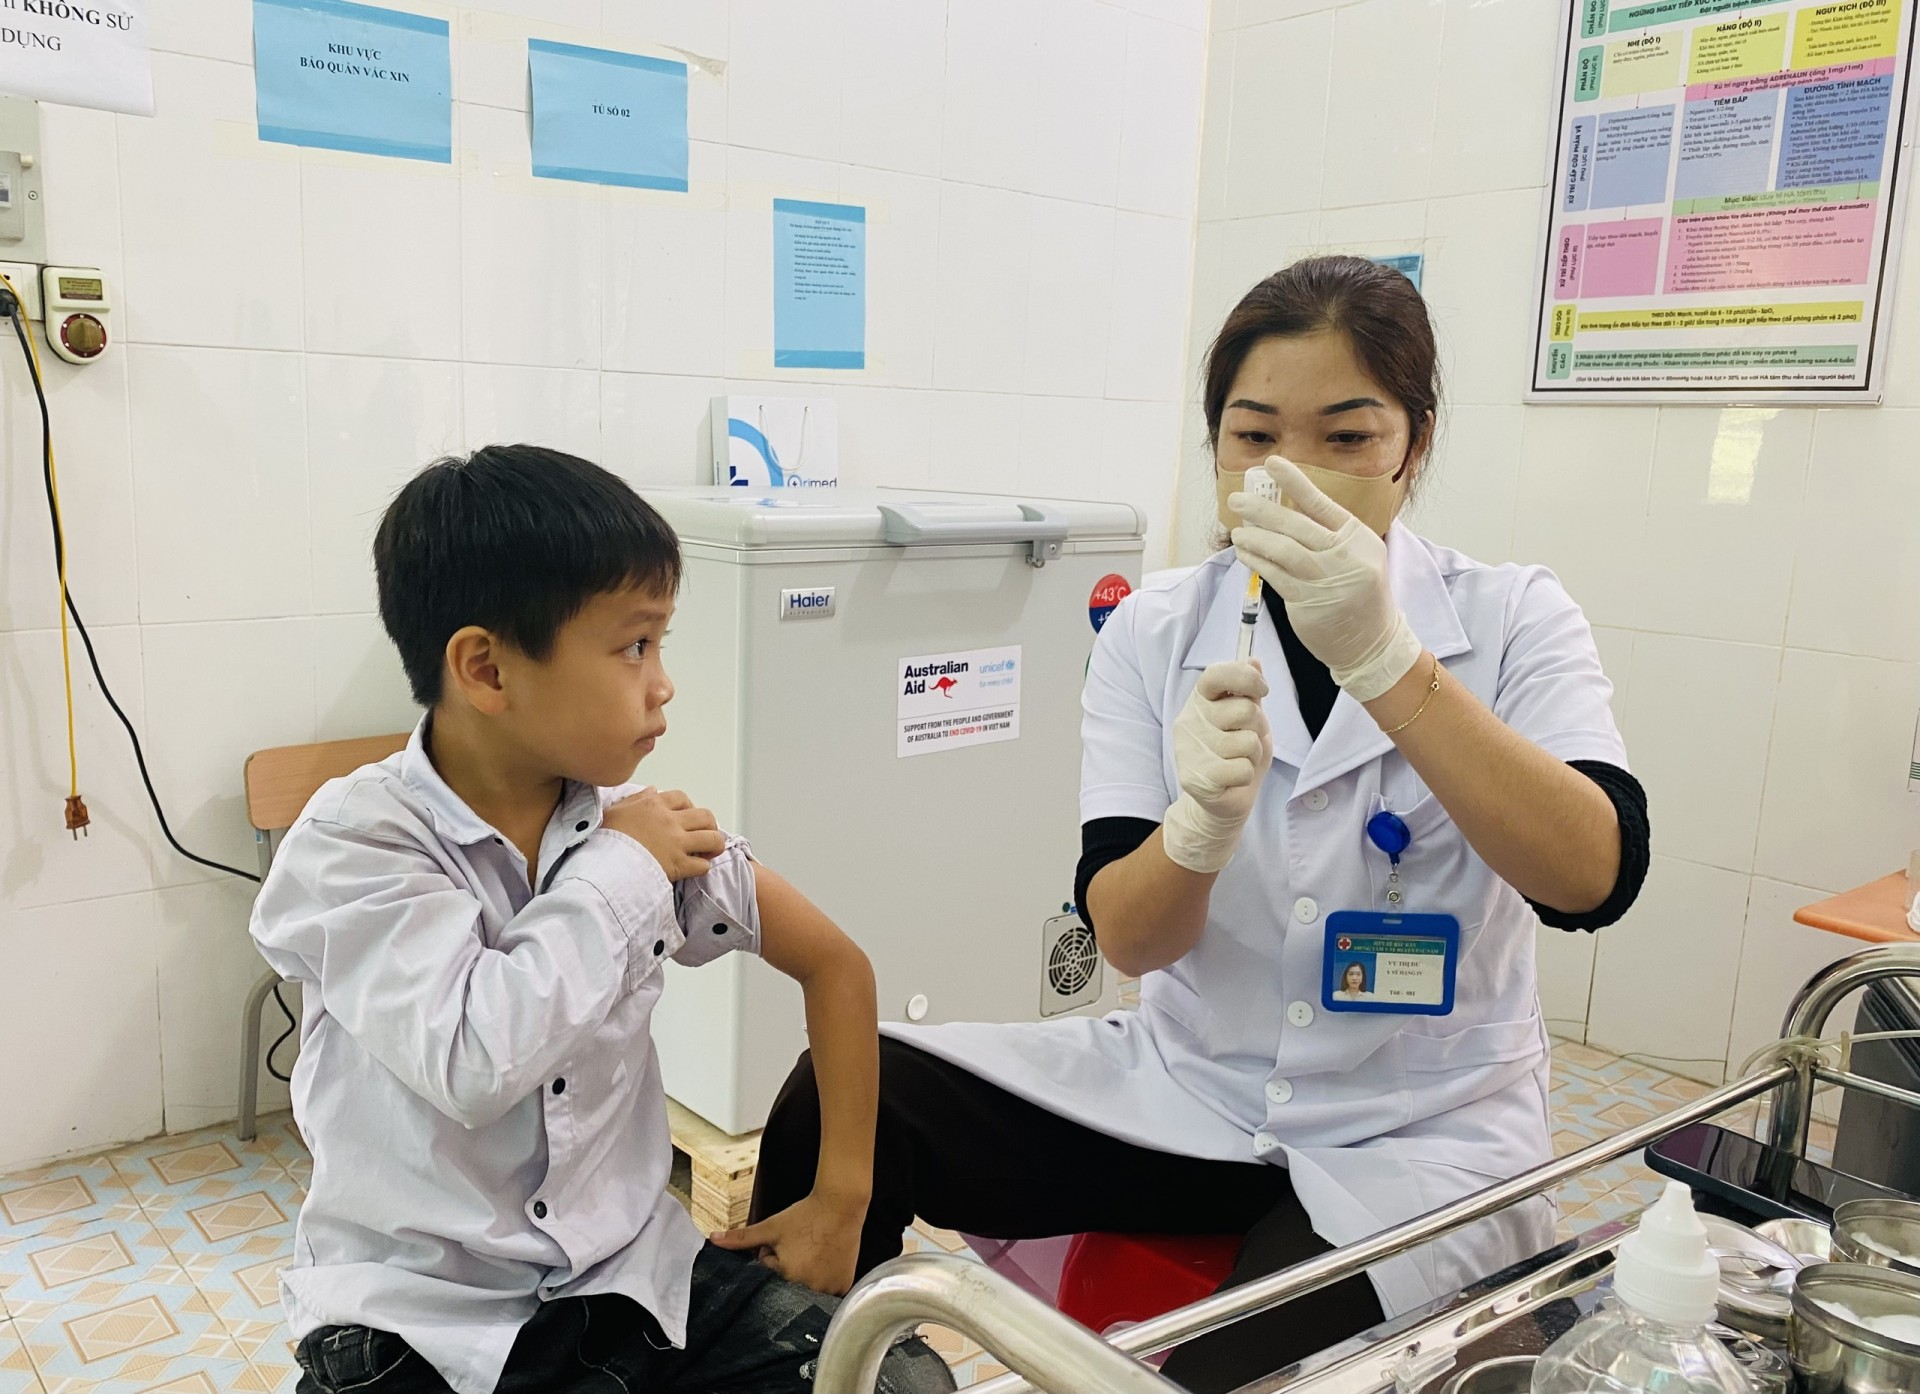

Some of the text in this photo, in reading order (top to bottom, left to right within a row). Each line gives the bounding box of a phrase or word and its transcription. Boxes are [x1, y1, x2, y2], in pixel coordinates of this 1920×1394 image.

[23, 0, 134, 31] KHÔNG SỬ
[1816, 6, 1837, 16] NGUY
[1839, 3, 1858, 13] KỊCH
[1, 27, 61, 49] DỤNG
[328, 43, 381, 61] KHU VỰC
[300, 56, 324, 69] BẢO
[327, 61, 360, 75] QUẢN
[390, 71, 409, 82] XIN
[621, 109, 630, 117] 02
[790, 592, 830, 609] Haier
[904, 661, 968, 679] Australian
[979, 660, 1005, 673] unicef
[904, 679, 925, 695] Aid
[904, 723, 927, 732] SUPPORT
[928, 721, 941, 729] FROM
[943, 719, 952, 727] THE
[953, 717, 971, 726] PEOPLE
[982, 710, 1014, 721] GOVERNMENT
[907, 735, 913, 743] OF
[915, 731, 941, 742] AUSTRALIA
[949, 729, 959, 737] END
[960, 726, 982, 735] COVID-19
[989, 723, 999, 731] VIET
